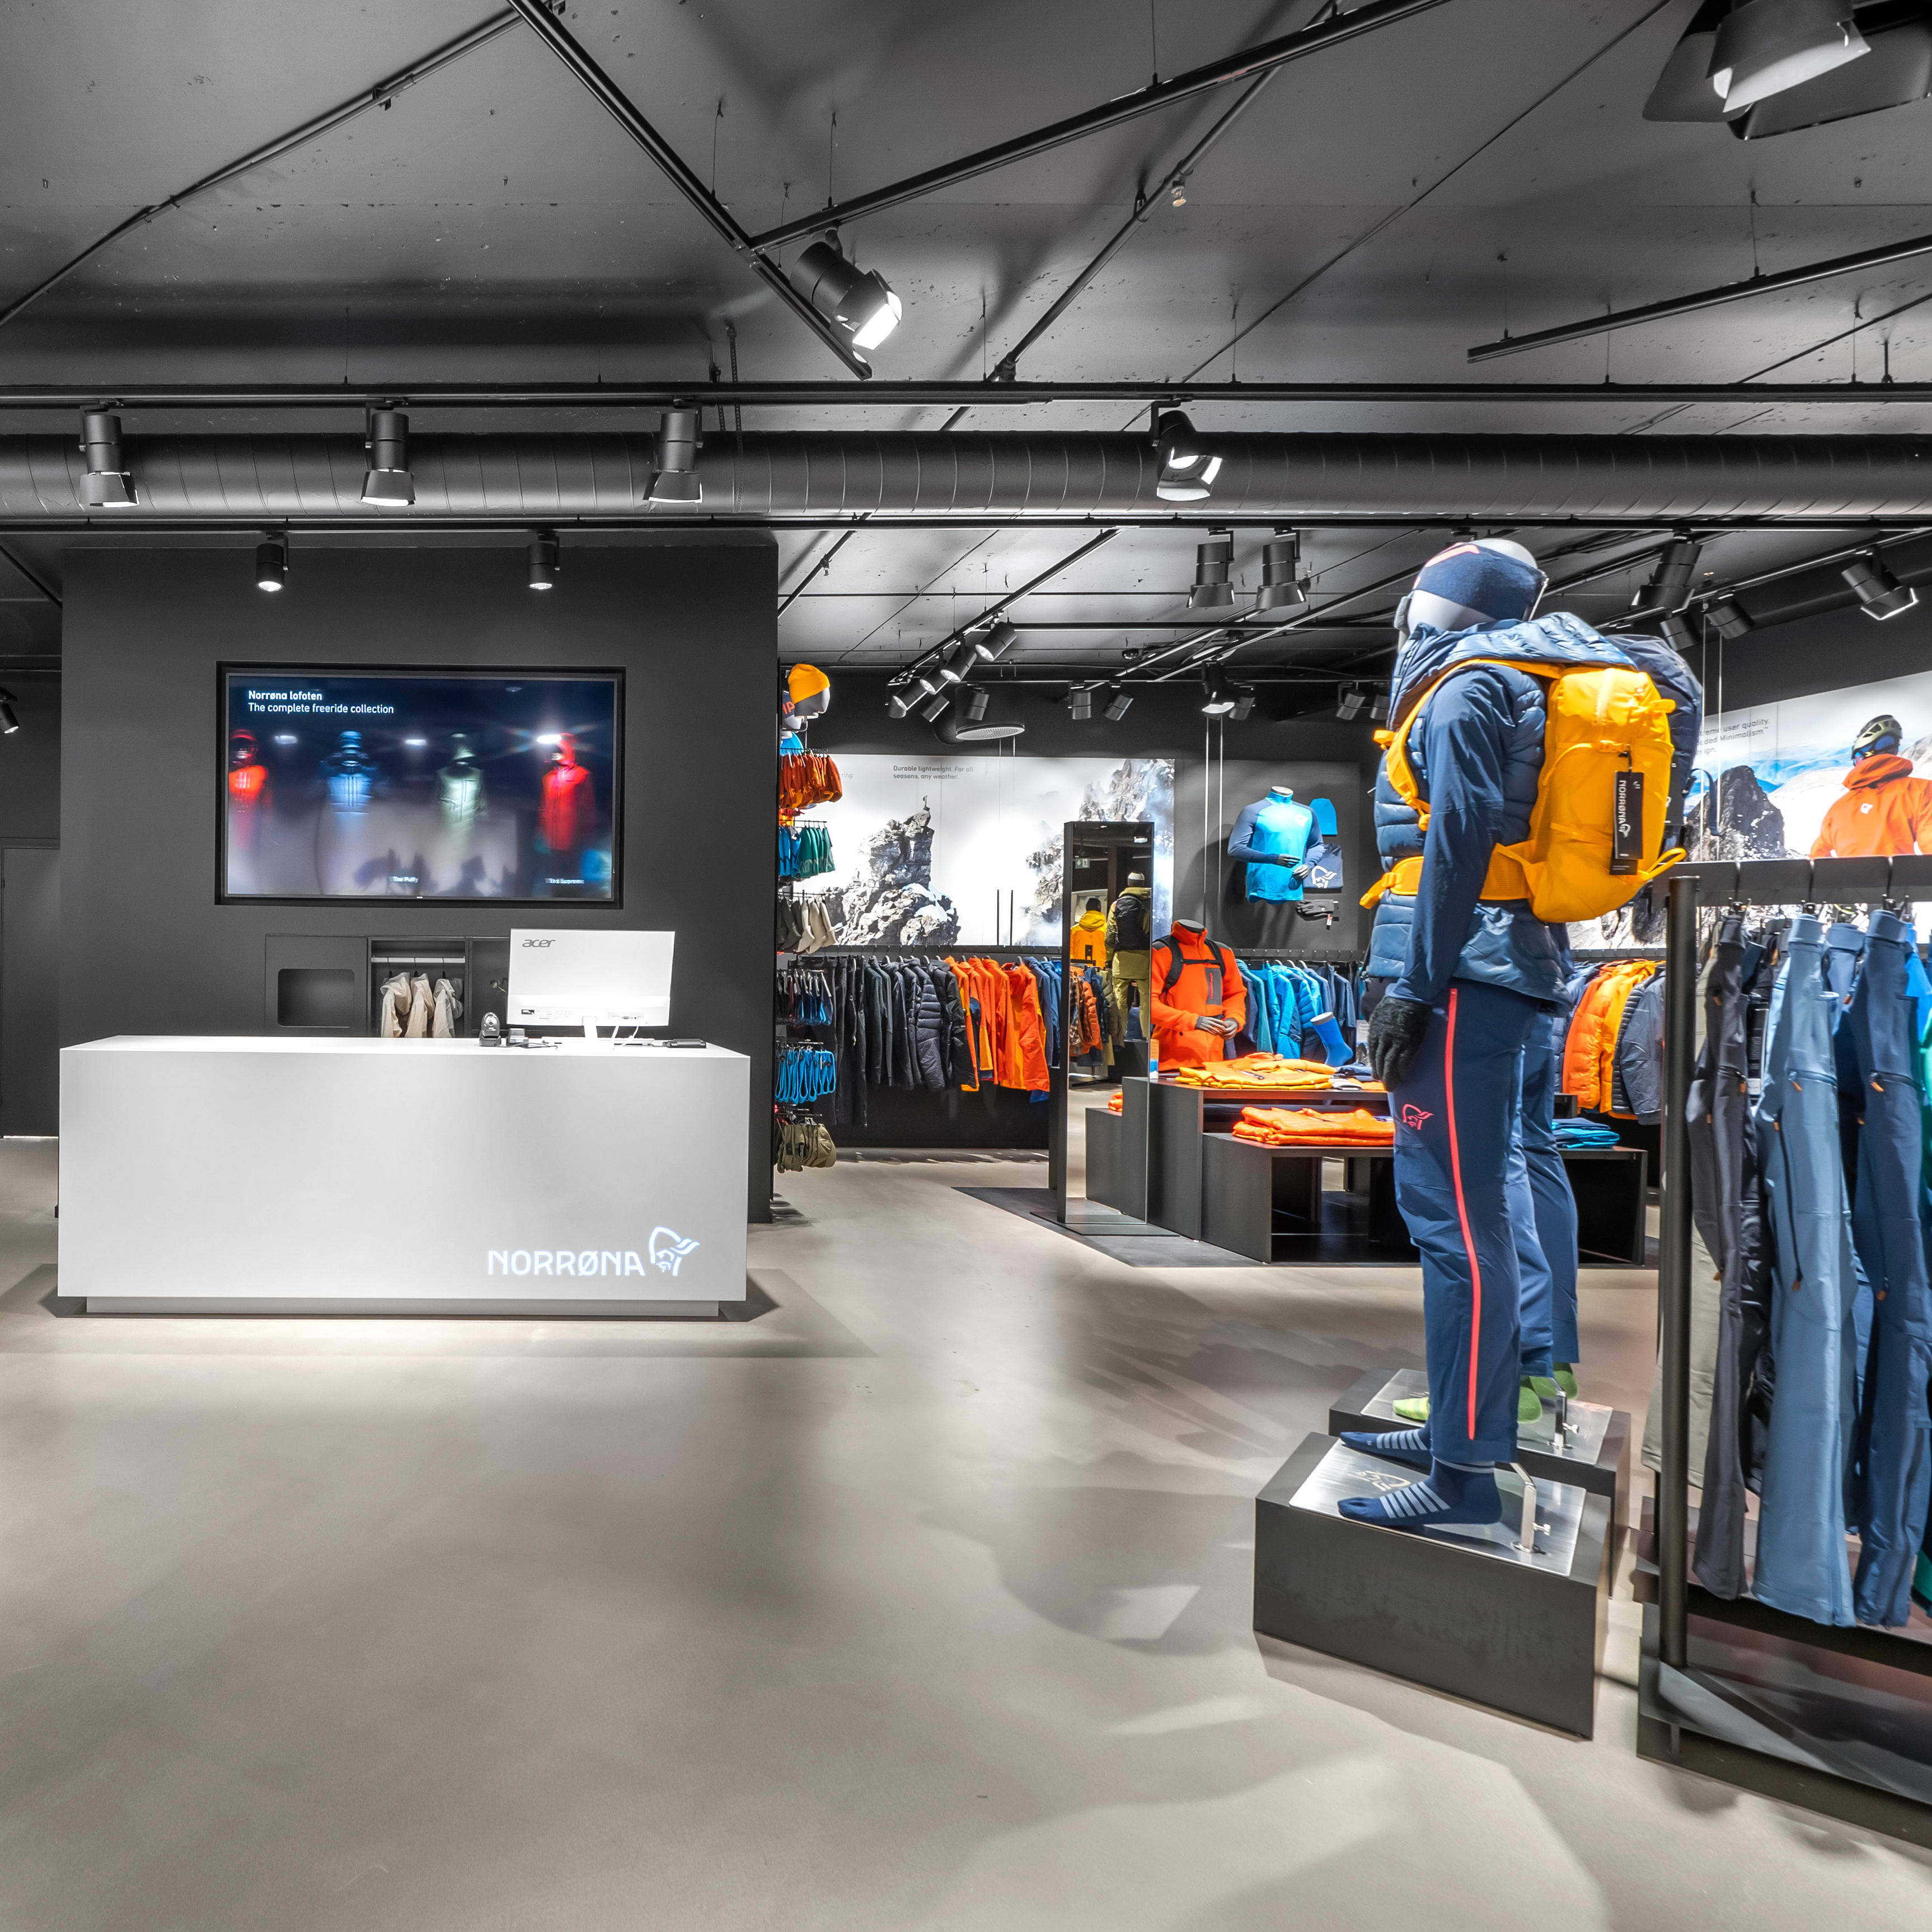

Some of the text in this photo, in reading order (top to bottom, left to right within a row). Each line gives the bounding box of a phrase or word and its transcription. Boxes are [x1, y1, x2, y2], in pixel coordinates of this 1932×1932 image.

[248, 690, 322, 700] Norrøna lofoten
[248, 702, 394, 714] The complete freeride collection
[522, 939, 556, 948] acer
[487, 1250, 646, 1277] NORRØNA
